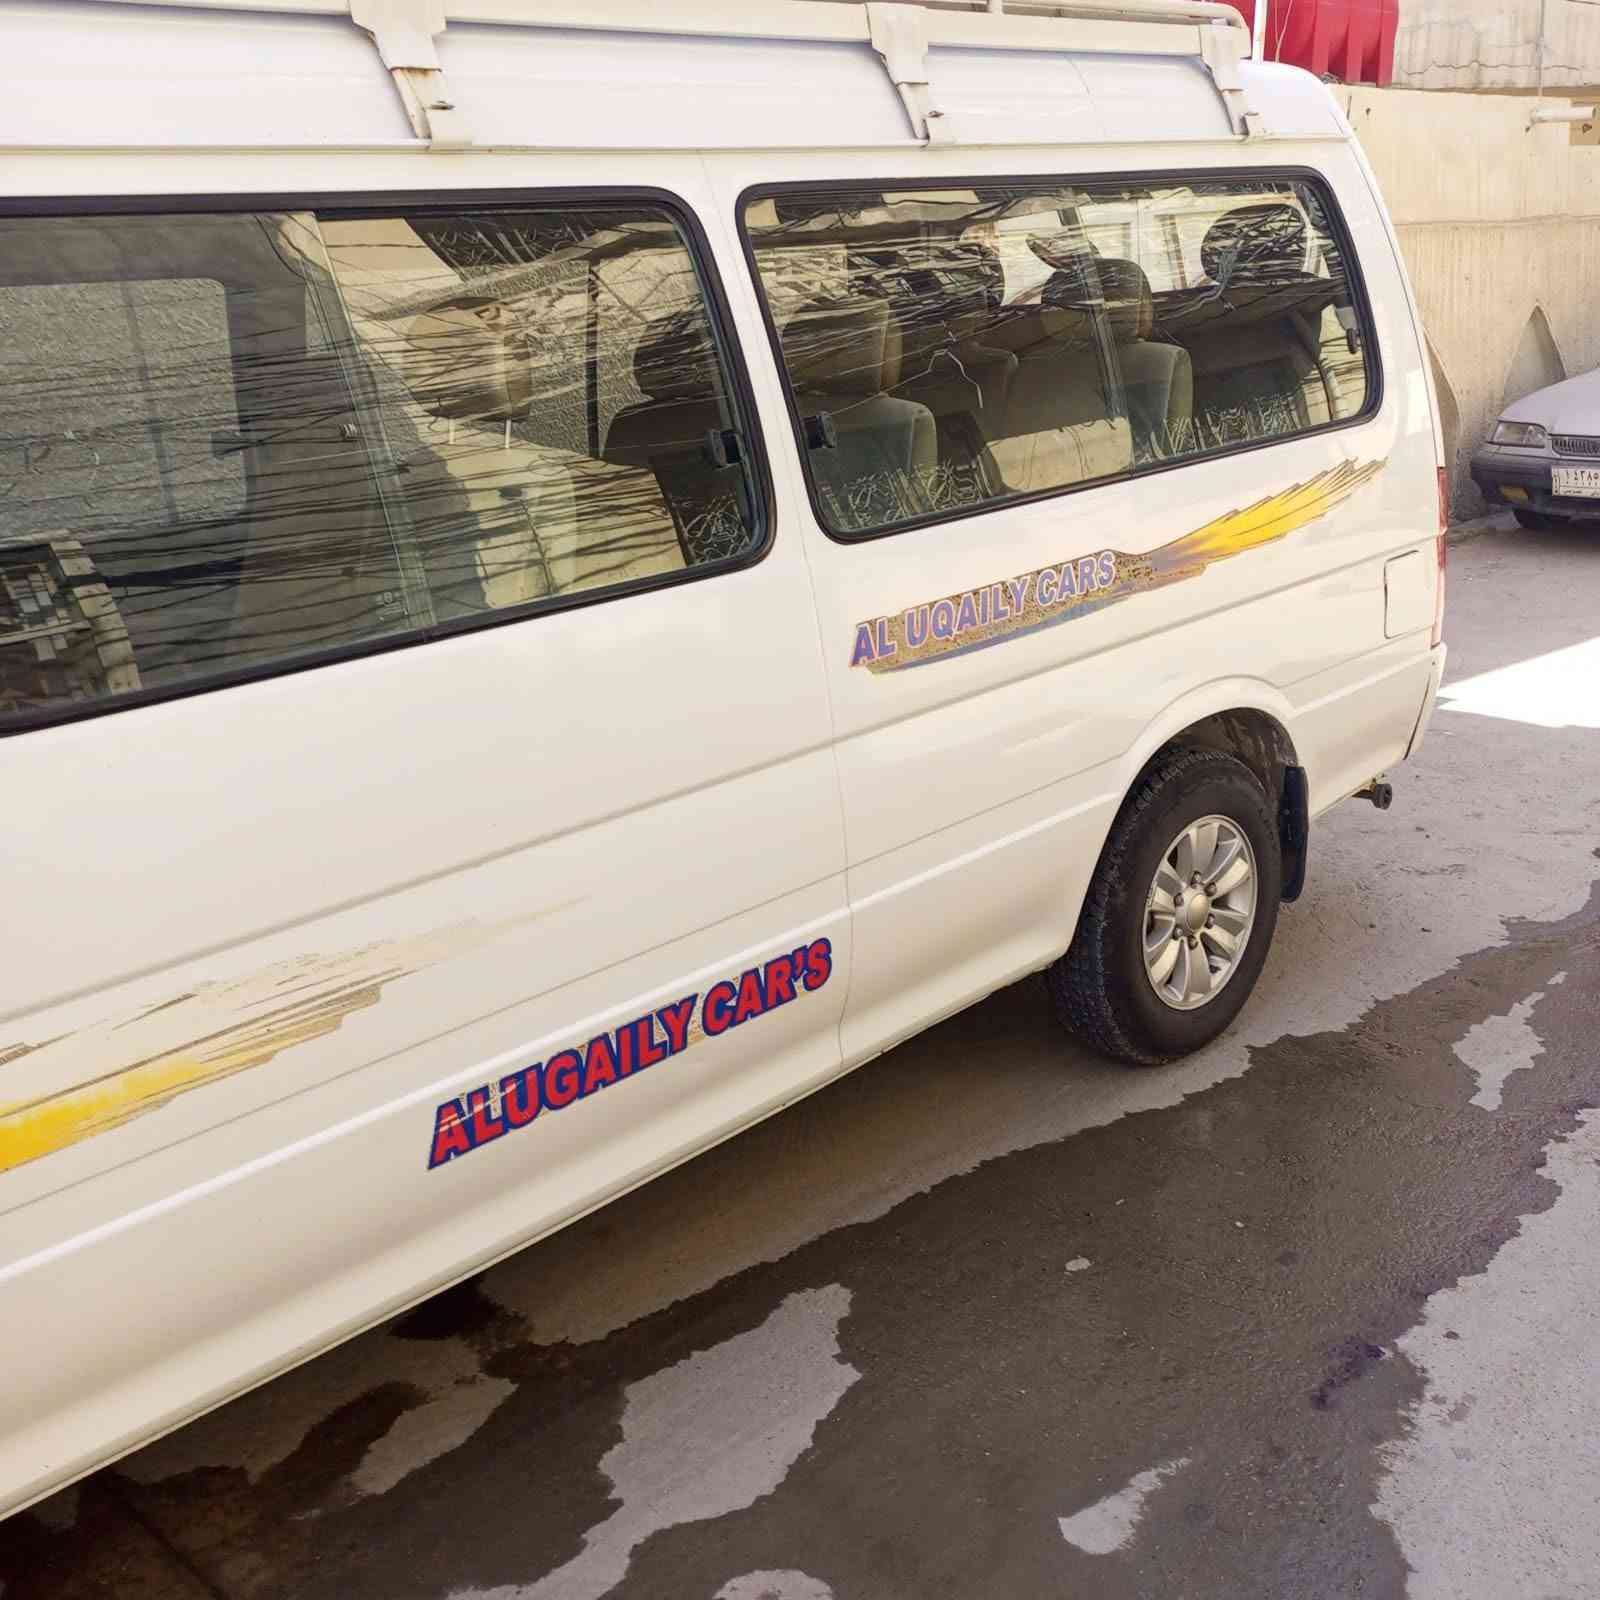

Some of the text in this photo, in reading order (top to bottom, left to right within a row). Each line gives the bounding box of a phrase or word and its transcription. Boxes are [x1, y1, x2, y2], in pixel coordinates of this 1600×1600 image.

[849, 550, 1116, 667] AL UQAILY CARS
[702, 937, 832, 1036] CAR'S
